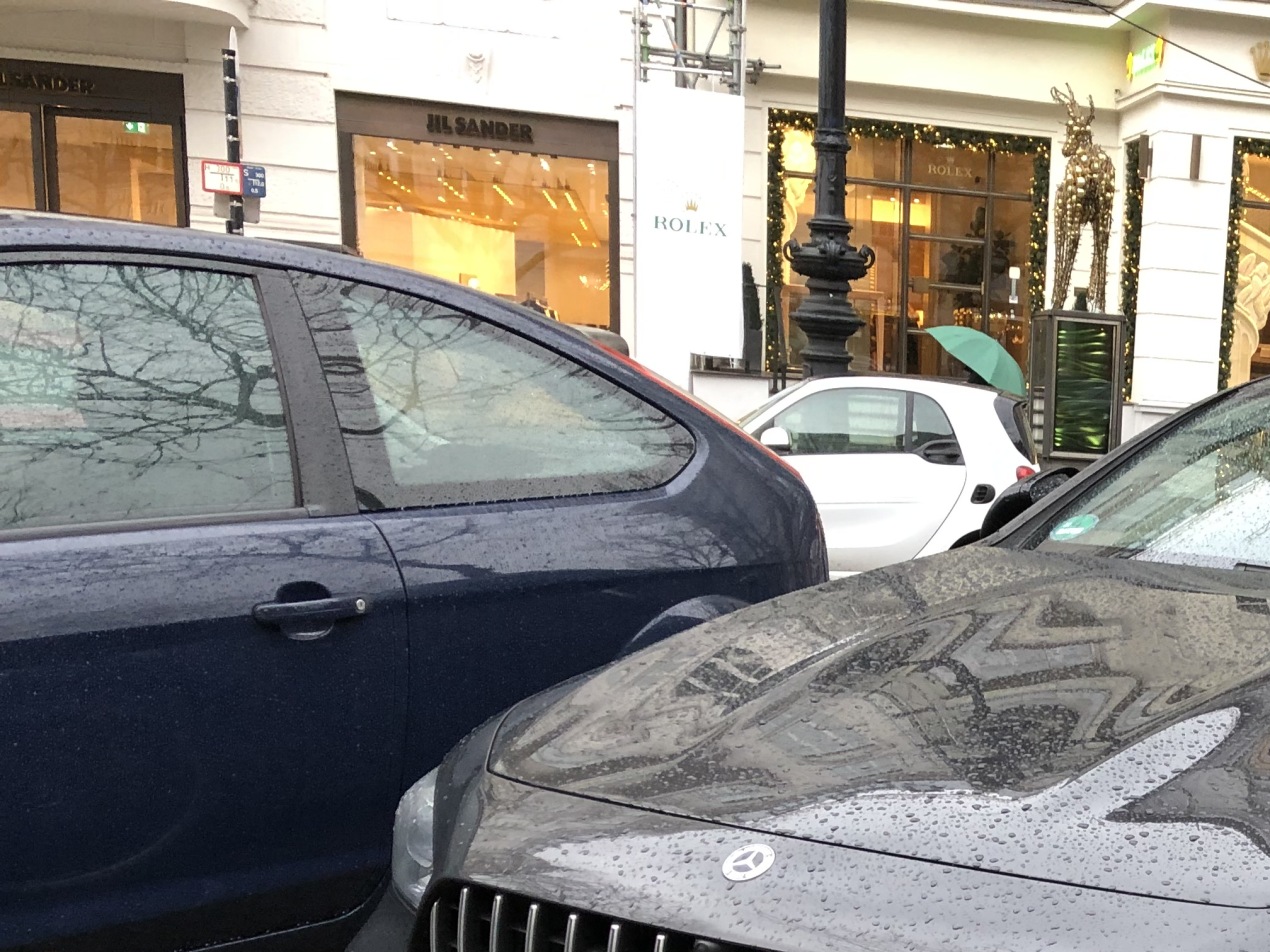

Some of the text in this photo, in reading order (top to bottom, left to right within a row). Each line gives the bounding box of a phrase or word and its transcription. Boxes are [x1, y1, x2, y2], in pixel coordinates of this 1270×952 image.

[426, 114, 535, 144] JIL SANDER
[928, 164, 973, 178] ROLEX
[654, 215, 727, 237] ROLEX
